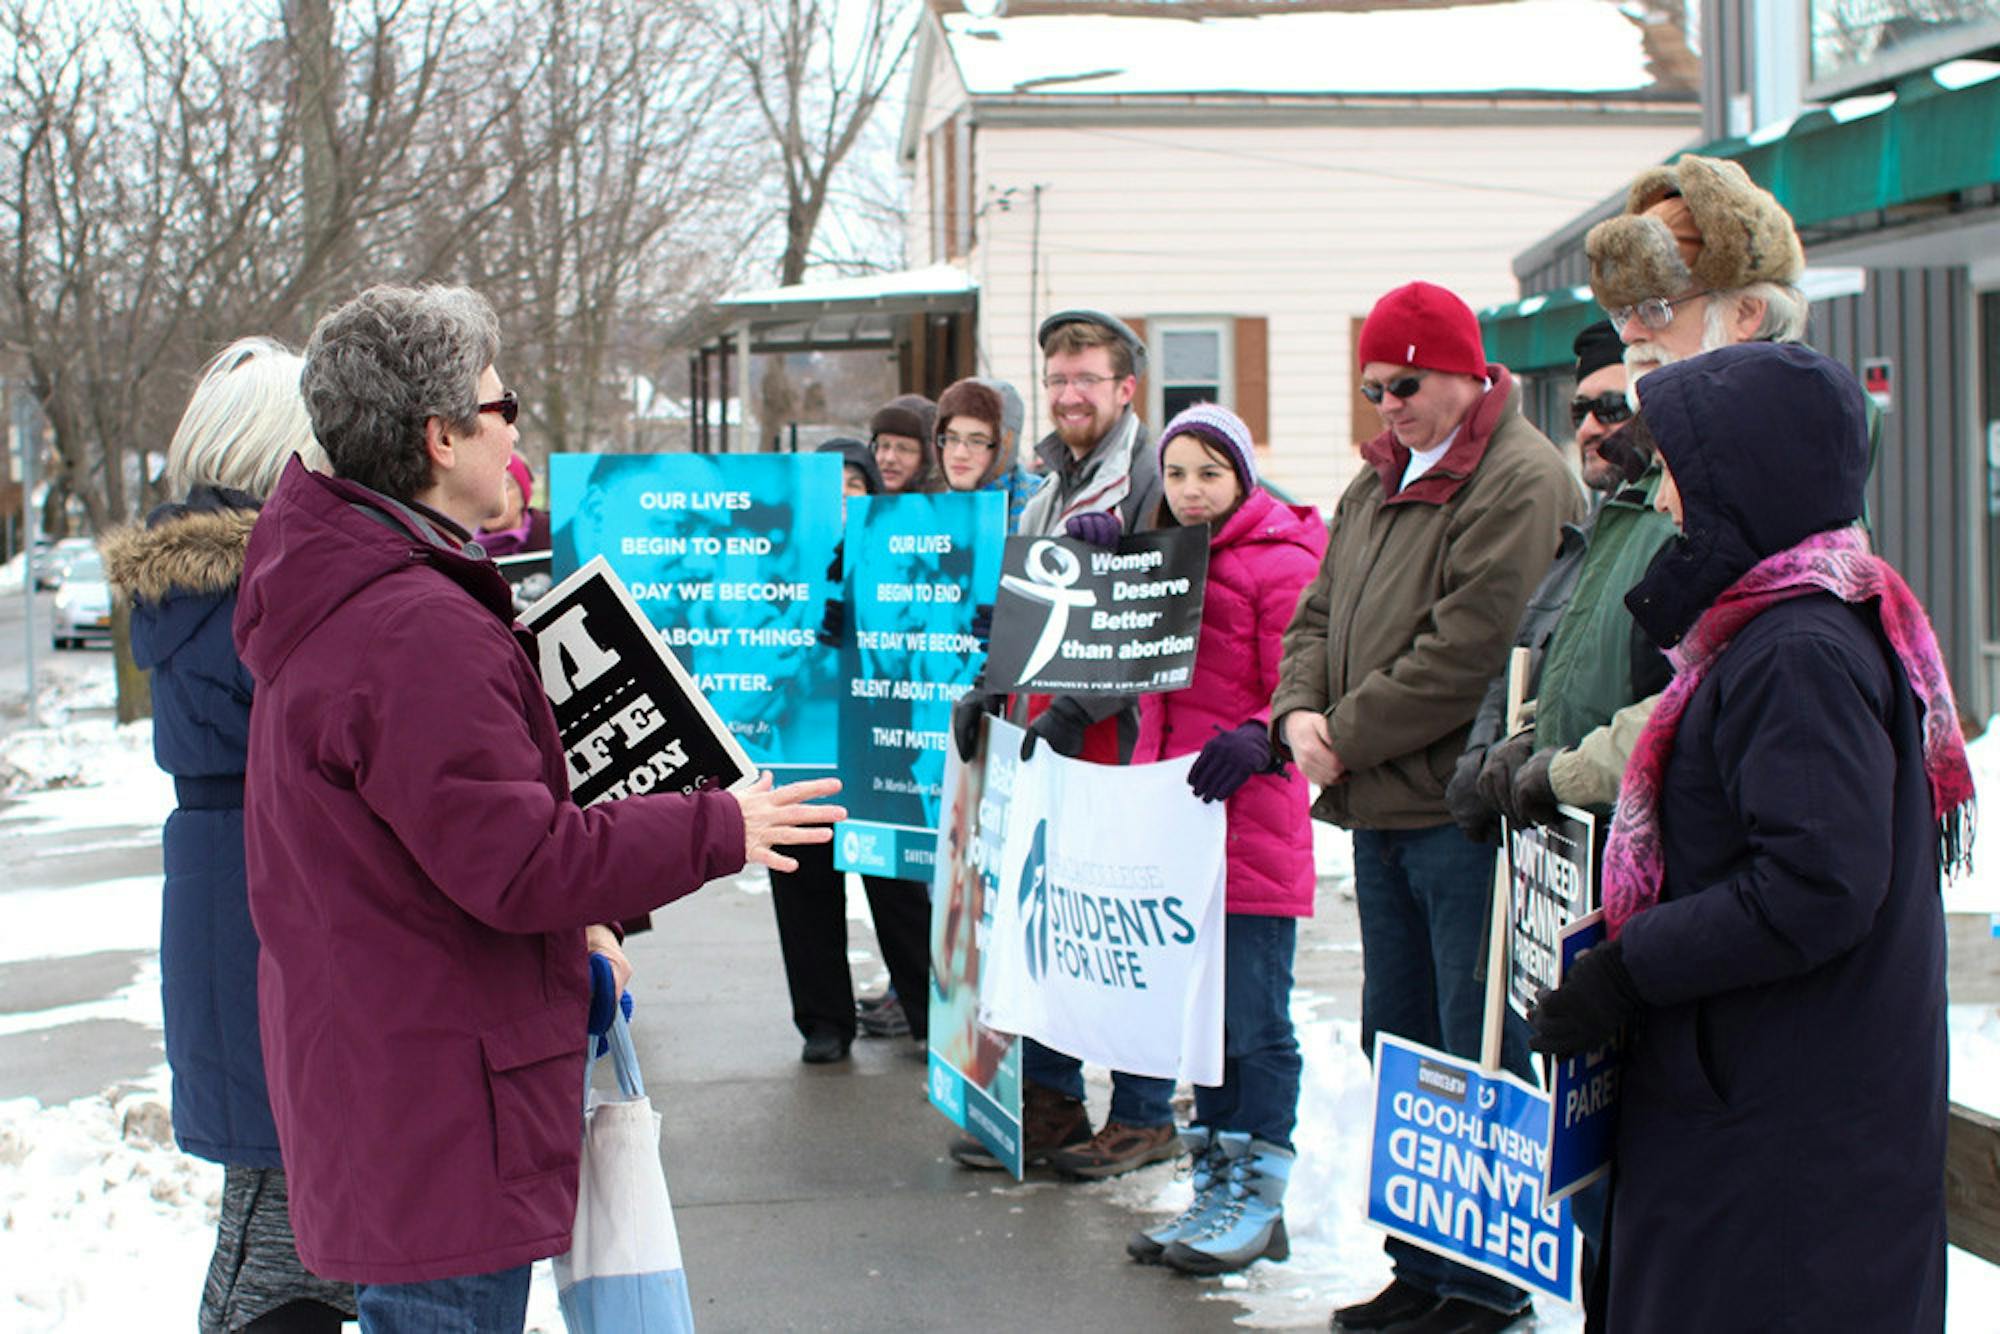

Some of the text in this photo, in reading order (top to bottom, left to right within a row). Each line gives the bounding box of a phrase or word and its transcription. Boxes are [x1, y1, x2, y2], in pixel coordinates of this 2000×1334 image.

[640, 491, 751, 511] OUR LIVES
[621, 537, 771, 556] BEGIN TO END
[889, 534, 952, 554] OUR LIVES
[1091, 550, 1163, 573] Women
[631, 583, 810, 601] DAY WE BECOME
[876, 583, 961, 603] BEGIN TO END
[1112, 577, 1191, 602] Deserve
[1091, 610, 1158, 631] Better
[660, 628, 817, 647] ABOUT THINGS
[857, 630, 879, 650] THE
[879, 632, 904, 651] DAY
[905, 633, 927, 652] WE
[1061, 635, 1195, 660] than abortion
[851, 678, 892, 698] SILENT
[891, 680, 935, 701] ABOUT
[872, 726, 904, 747] THAT
[1545, 847, 1580, 902] NEED
[1050, 883, 1197, 945] STUDENTS
[1054, 935, 1148, 991] FOR LIFE
[1384, 1174, 1560, 1282] DEFUND
